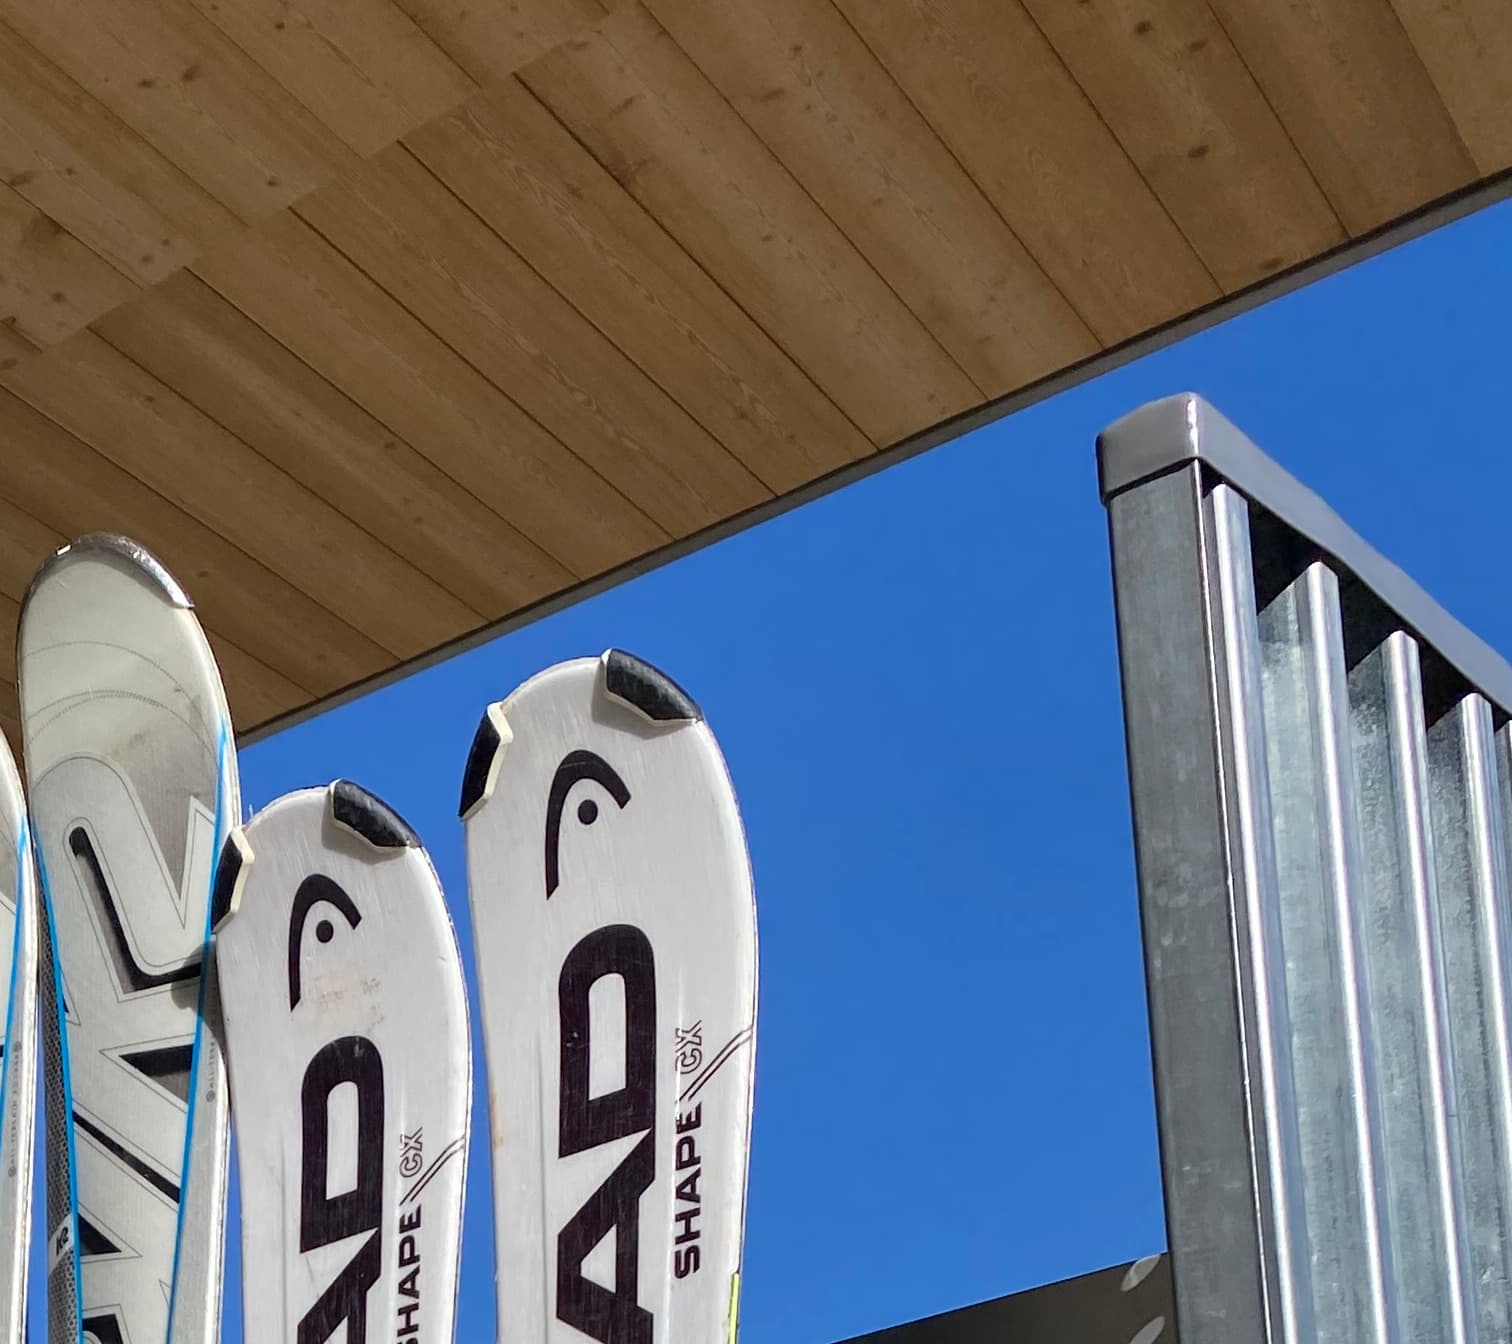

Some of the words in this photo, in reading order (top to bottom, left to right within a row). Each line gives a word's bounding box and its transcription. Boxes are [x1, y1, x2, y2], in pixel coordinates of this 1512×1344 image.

[676, 1017, 704, 1076] CX
[399, 1125, 424, 1182] CX
[674, 1102, 702, 1279] SHAPE
